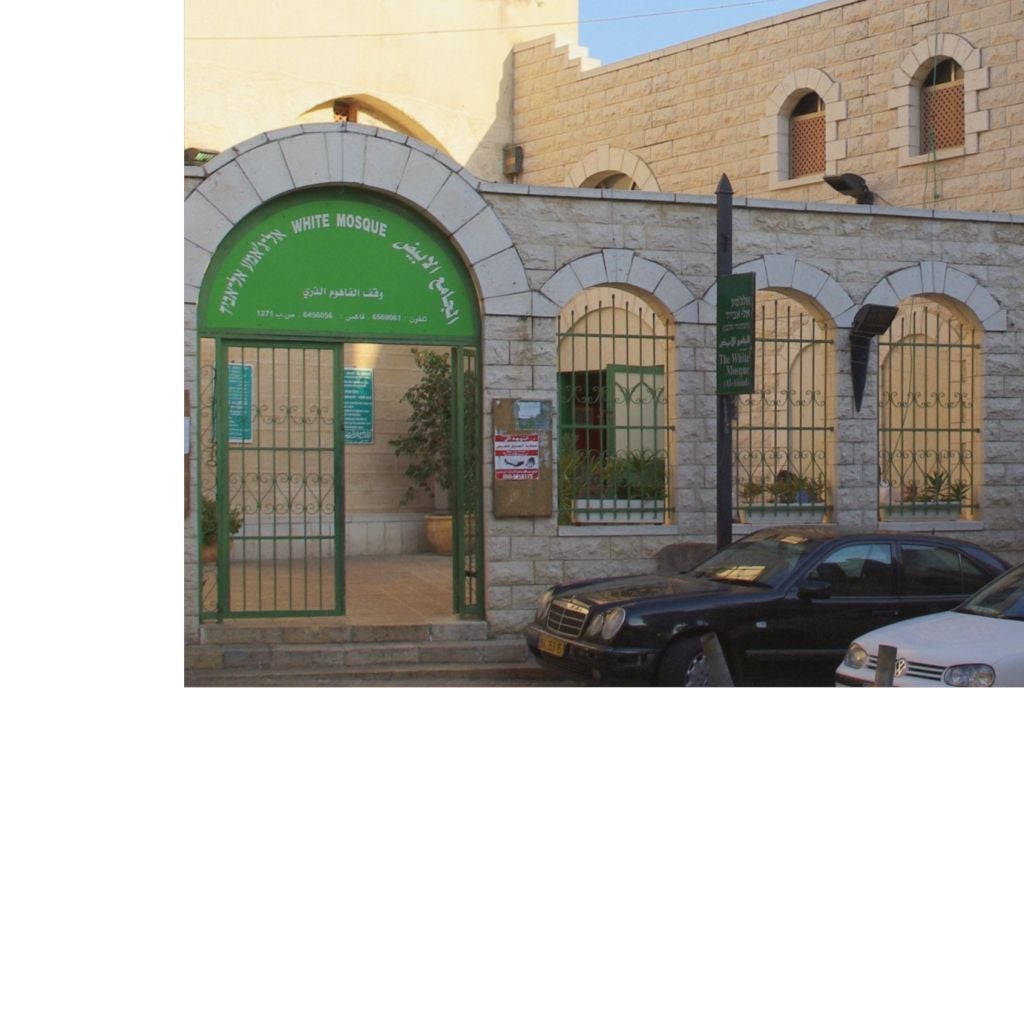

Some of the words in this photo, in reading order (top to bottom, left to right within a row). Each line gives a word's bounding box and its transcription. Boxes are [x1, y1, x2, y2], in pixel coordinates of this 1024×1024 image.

[291, 213, 331, 235] WHITE
[336, 212, 388, 238] MOSQUE
[391, 240, 442, 274] الابيض
[362, 287, 384, 301] وقف
[428, 276, 460, 325] الجامع
[719, 354, 731, 365] The
[731, 352, 750, 364] White
[726, 365, 751, 377] Mosque
